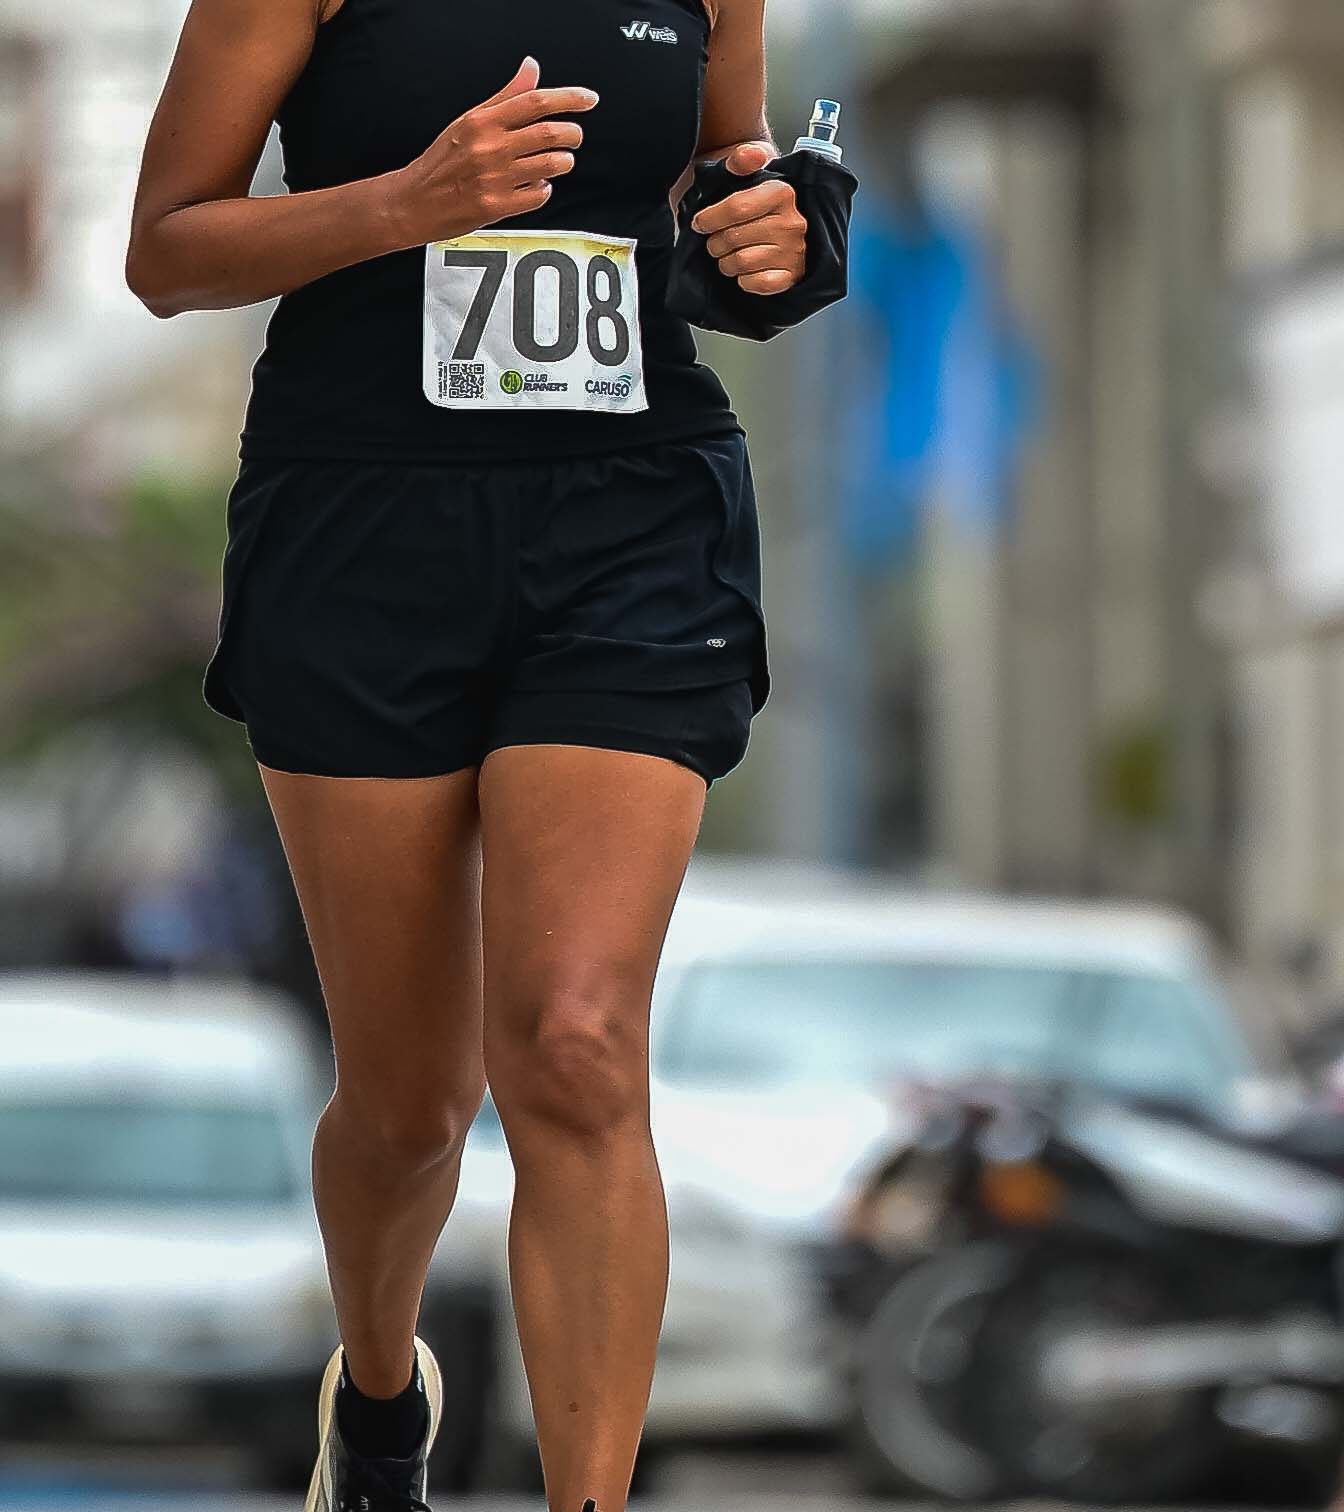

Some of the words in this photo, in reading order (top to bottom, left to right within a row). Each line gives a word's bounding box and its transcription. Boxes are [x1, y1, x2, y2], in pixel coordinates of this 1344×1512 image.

[444, 249, 630, 366] 708
[524, 374, 548, 382] CLUB
[584, 380, 631, 397] CARUSO
